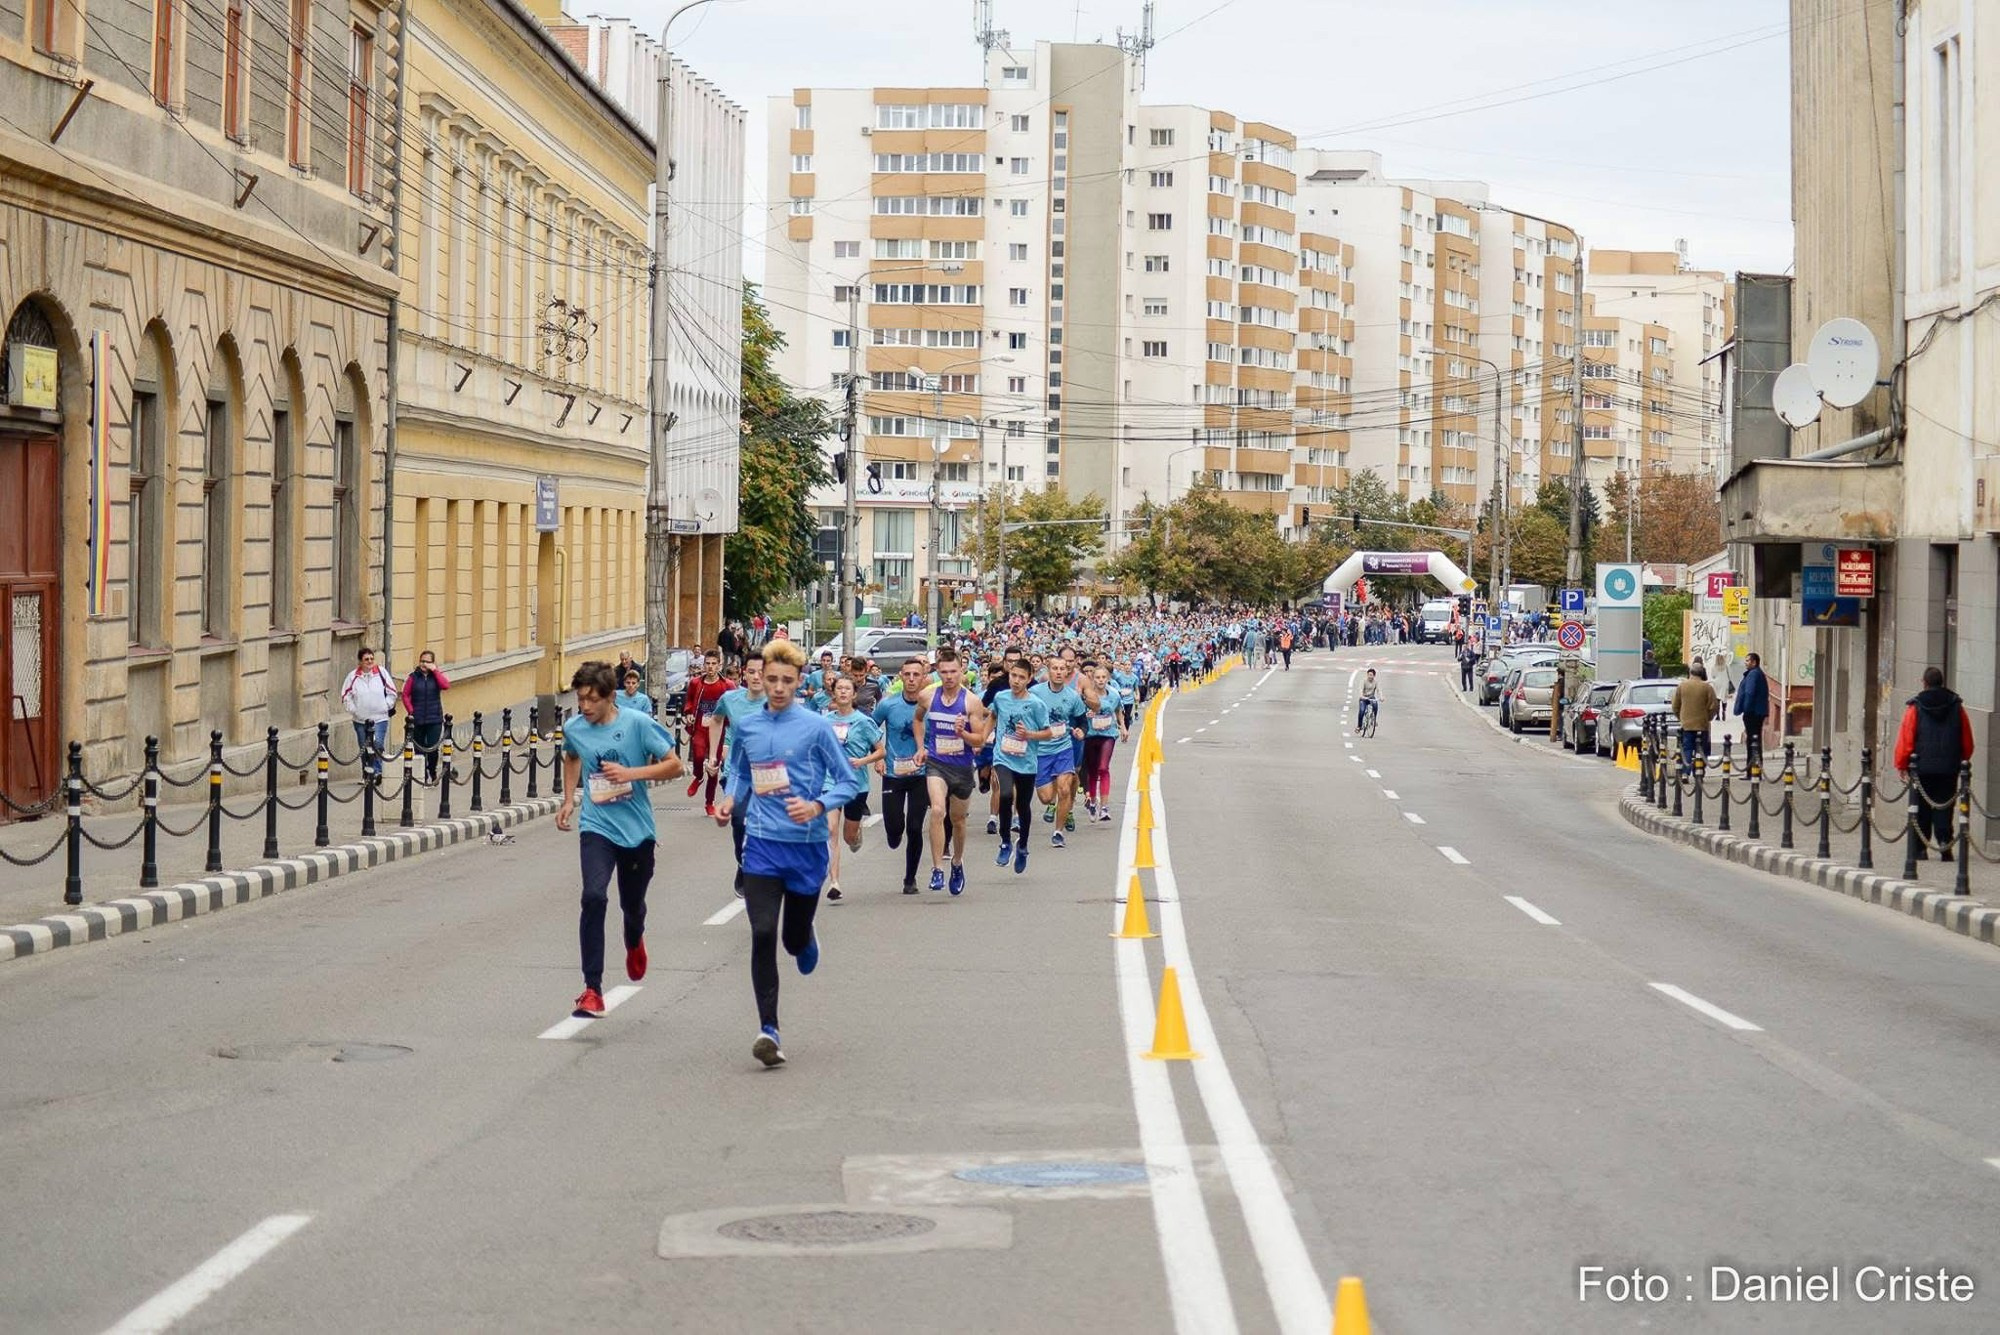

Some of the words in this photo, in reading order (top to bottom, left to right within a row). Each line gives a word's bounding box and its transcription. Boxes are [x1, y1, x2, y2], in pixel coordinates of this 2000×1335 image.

[1713, 577, 1728, 595] T
[1565, 591, 1579, 610] P
[1489, 618, 1499, 630] P
